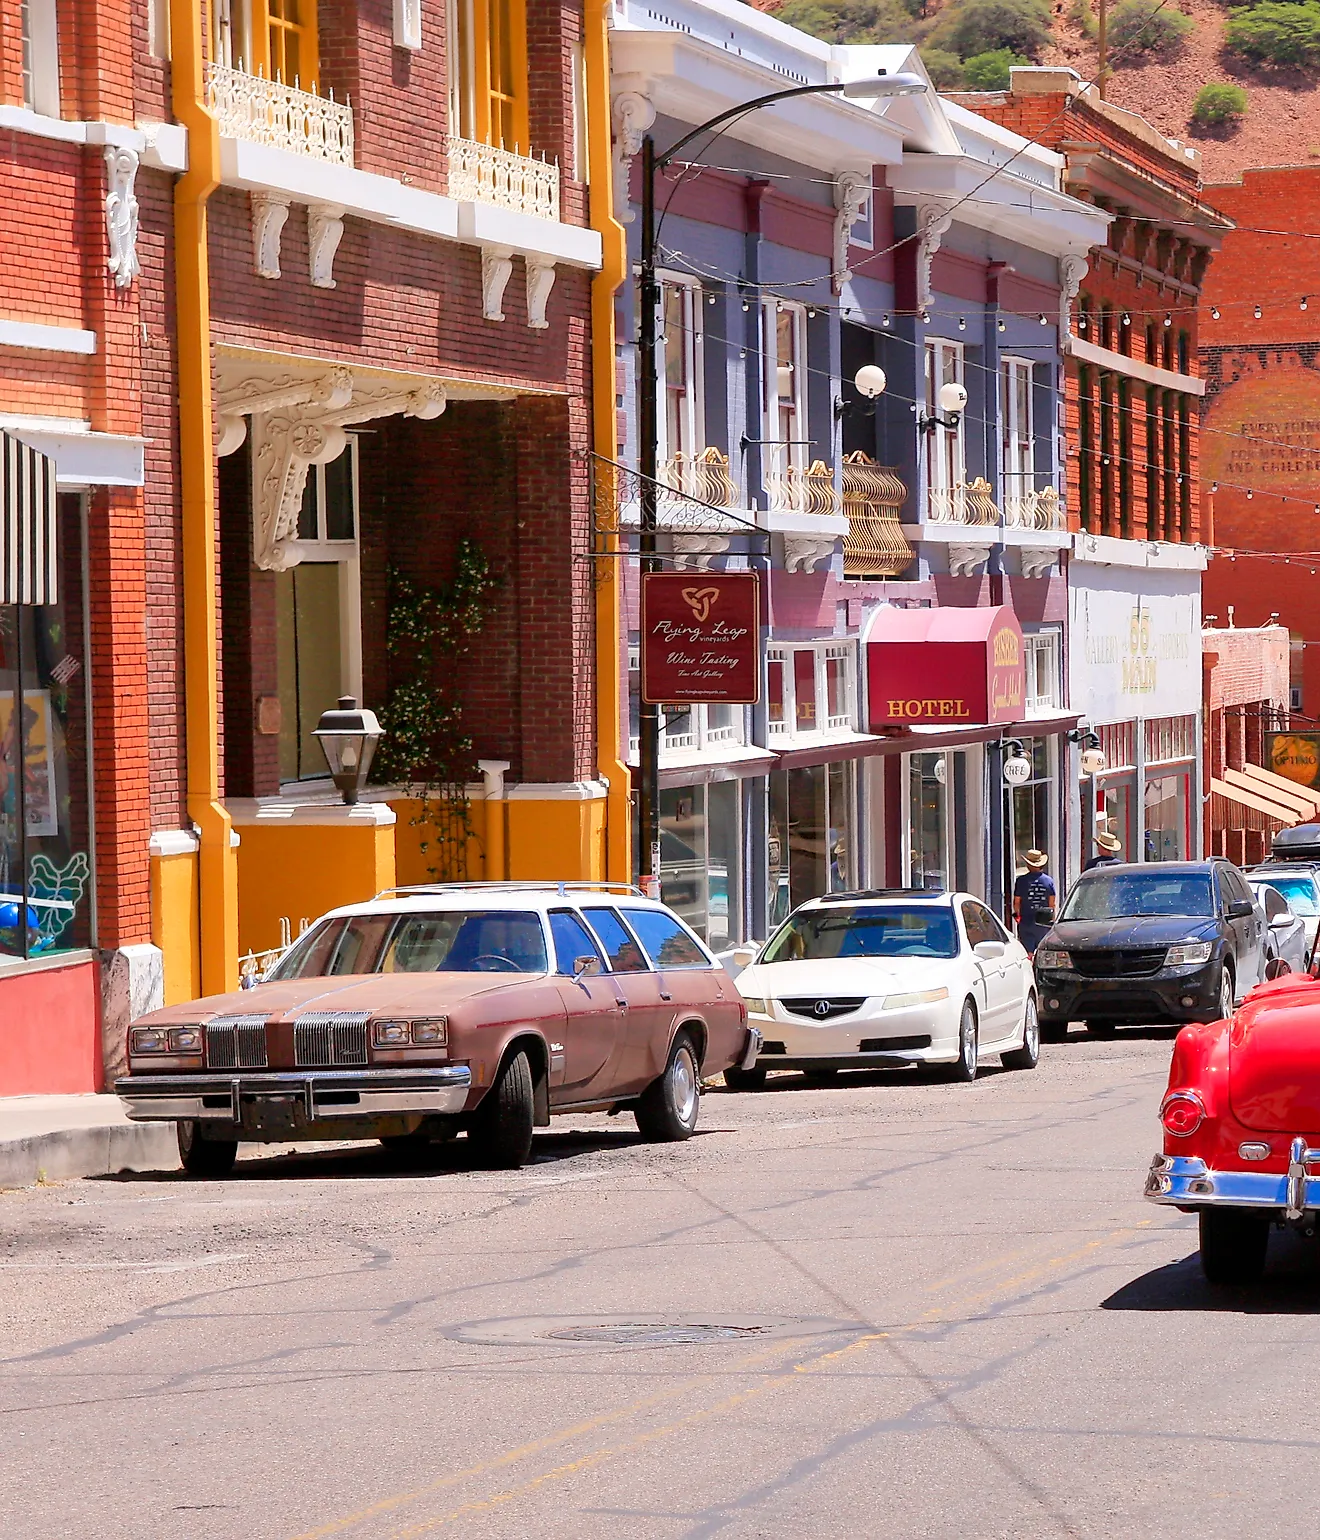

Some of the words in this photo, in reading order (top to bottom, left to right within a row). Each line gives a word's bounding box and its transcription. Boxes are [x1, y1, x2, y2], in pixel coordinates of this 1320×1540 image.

[1226, 461, 1254, 473] AND
[652, 620, 703, 642] Flying
[711, 620, 748, 640] Leap
[700, 635, 730, 643] vineyards
[666, 652, 696, 664] Wine
[700, 652, 740, 669] Tasting
[887, 699, 970, 717] HOTEL
